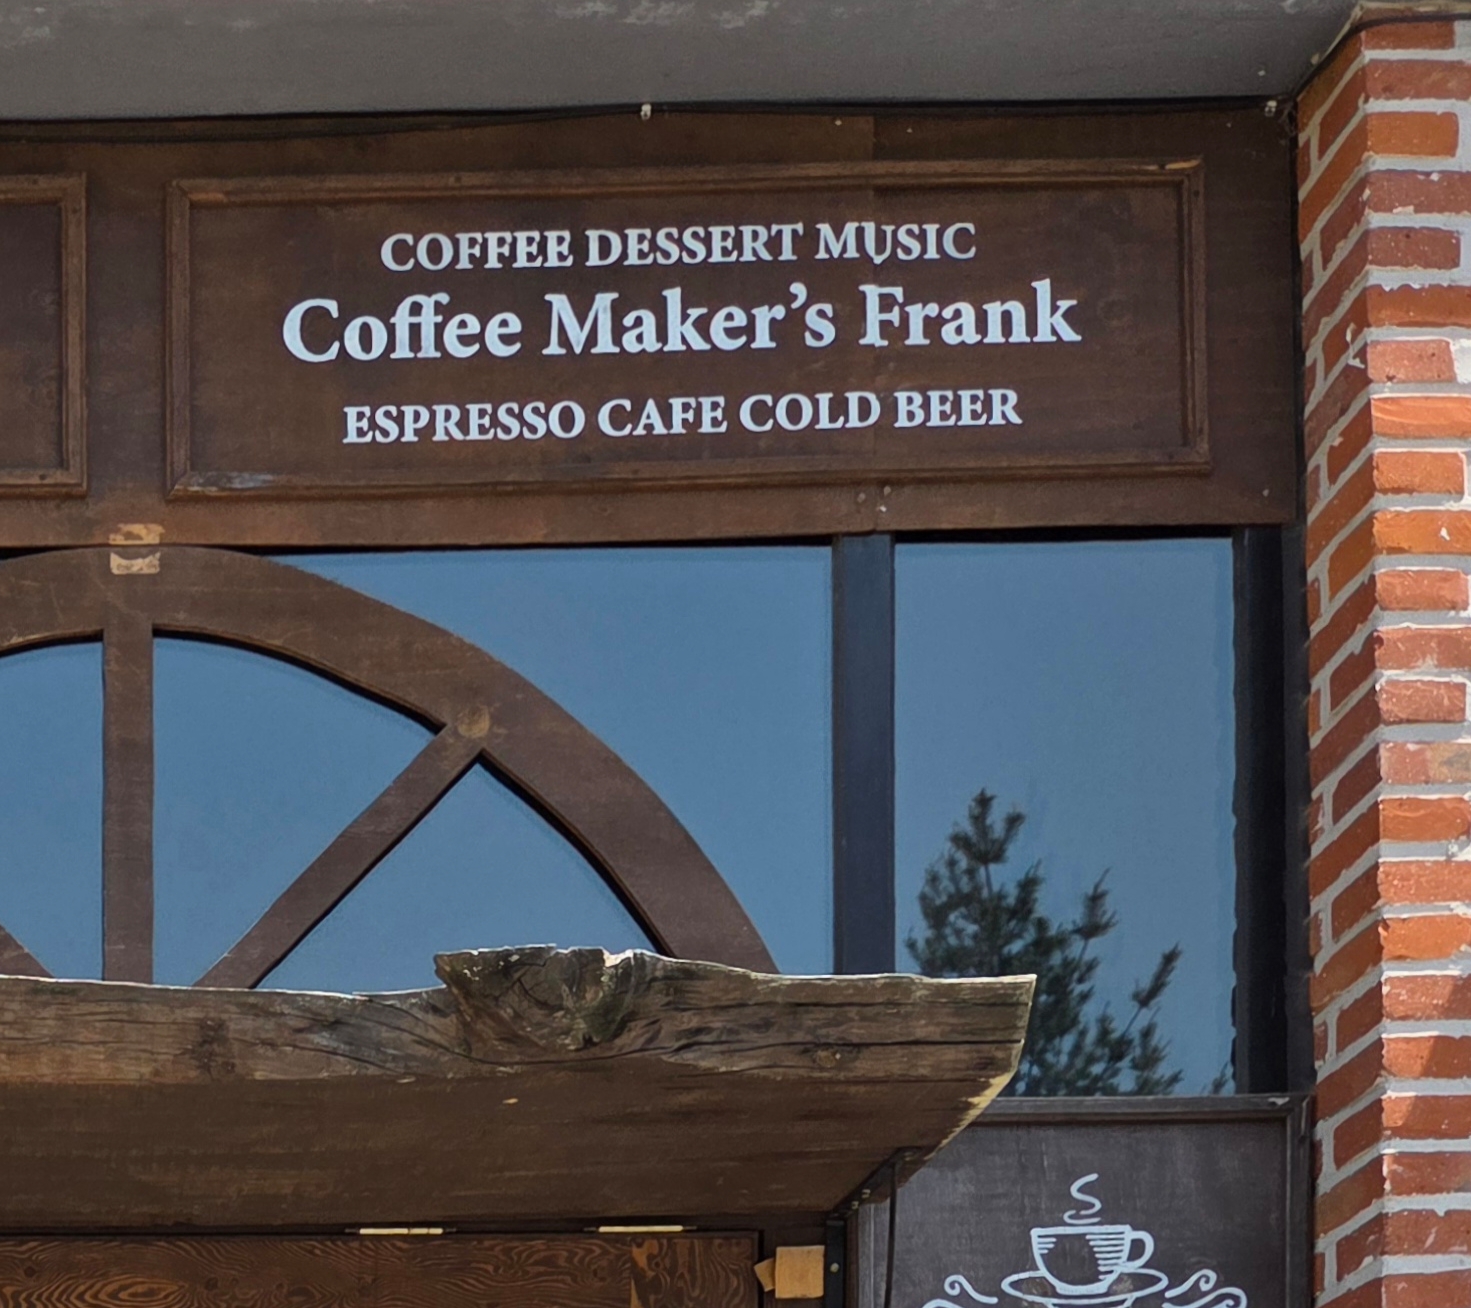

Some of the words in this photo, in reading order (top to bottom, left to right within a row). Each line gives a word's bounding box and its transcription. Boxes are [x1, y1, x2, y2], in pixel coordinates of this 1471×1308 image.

[381, 231, 573, 271] COFFEE
[585, 223, 804, 267] DESSERT
[815, 222, 976, 265] MUSIC
[282, 293, 522, 363] Coffee
[542, 283, 836, 355] Maker's
[859, 278, 1082, 347] Frank
[342, 401, 586, 444] ESPRESSO
[597, 396, 728, 437] CAFE
[739, 392, 881, 431] COLD
[893, 389, 1023, 428] BEER
